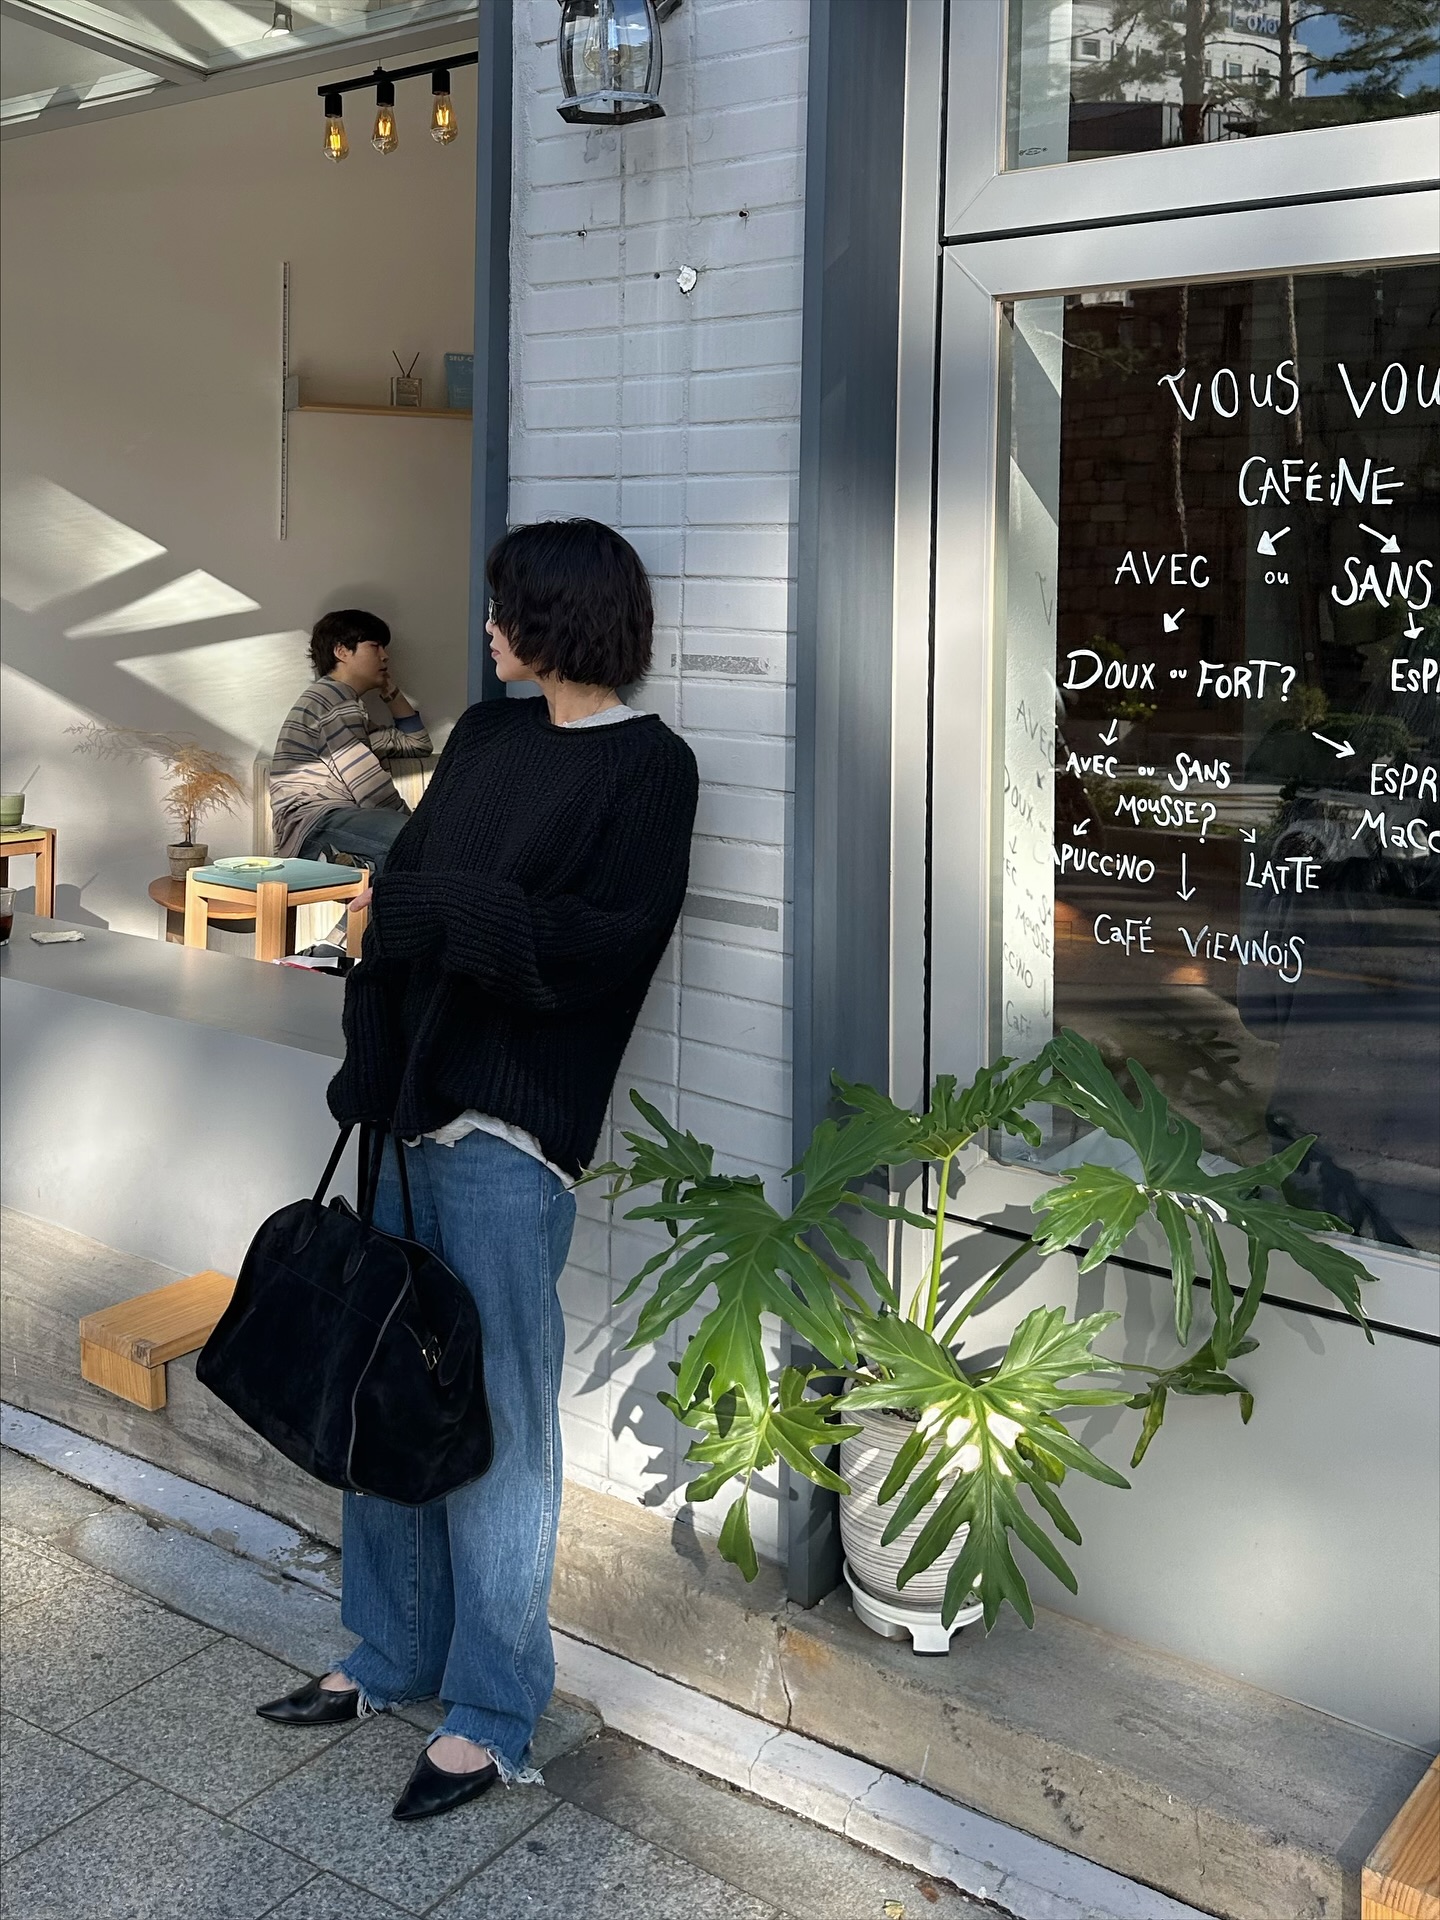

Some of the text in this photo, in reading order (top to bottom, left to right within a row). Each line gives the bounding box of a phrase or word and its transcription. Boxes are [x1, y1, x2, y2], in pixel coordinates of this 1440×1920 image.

[1115, 551, 1209, 587] AVEC
[1332, 557, 1432, 609] SANS
[1063, 650, 1155, 689] DOUX
[1197, 660, 1295, 701] FORT?
[1392, 659, 1440, 693] ESP
[1065, 751, 1119, 780] AVEC
[1166, 750, 1232, 793] SANS
[1114, 794, 1218, 844] MOUSSE?
[1244, 850, 1322, 895] LATTE
